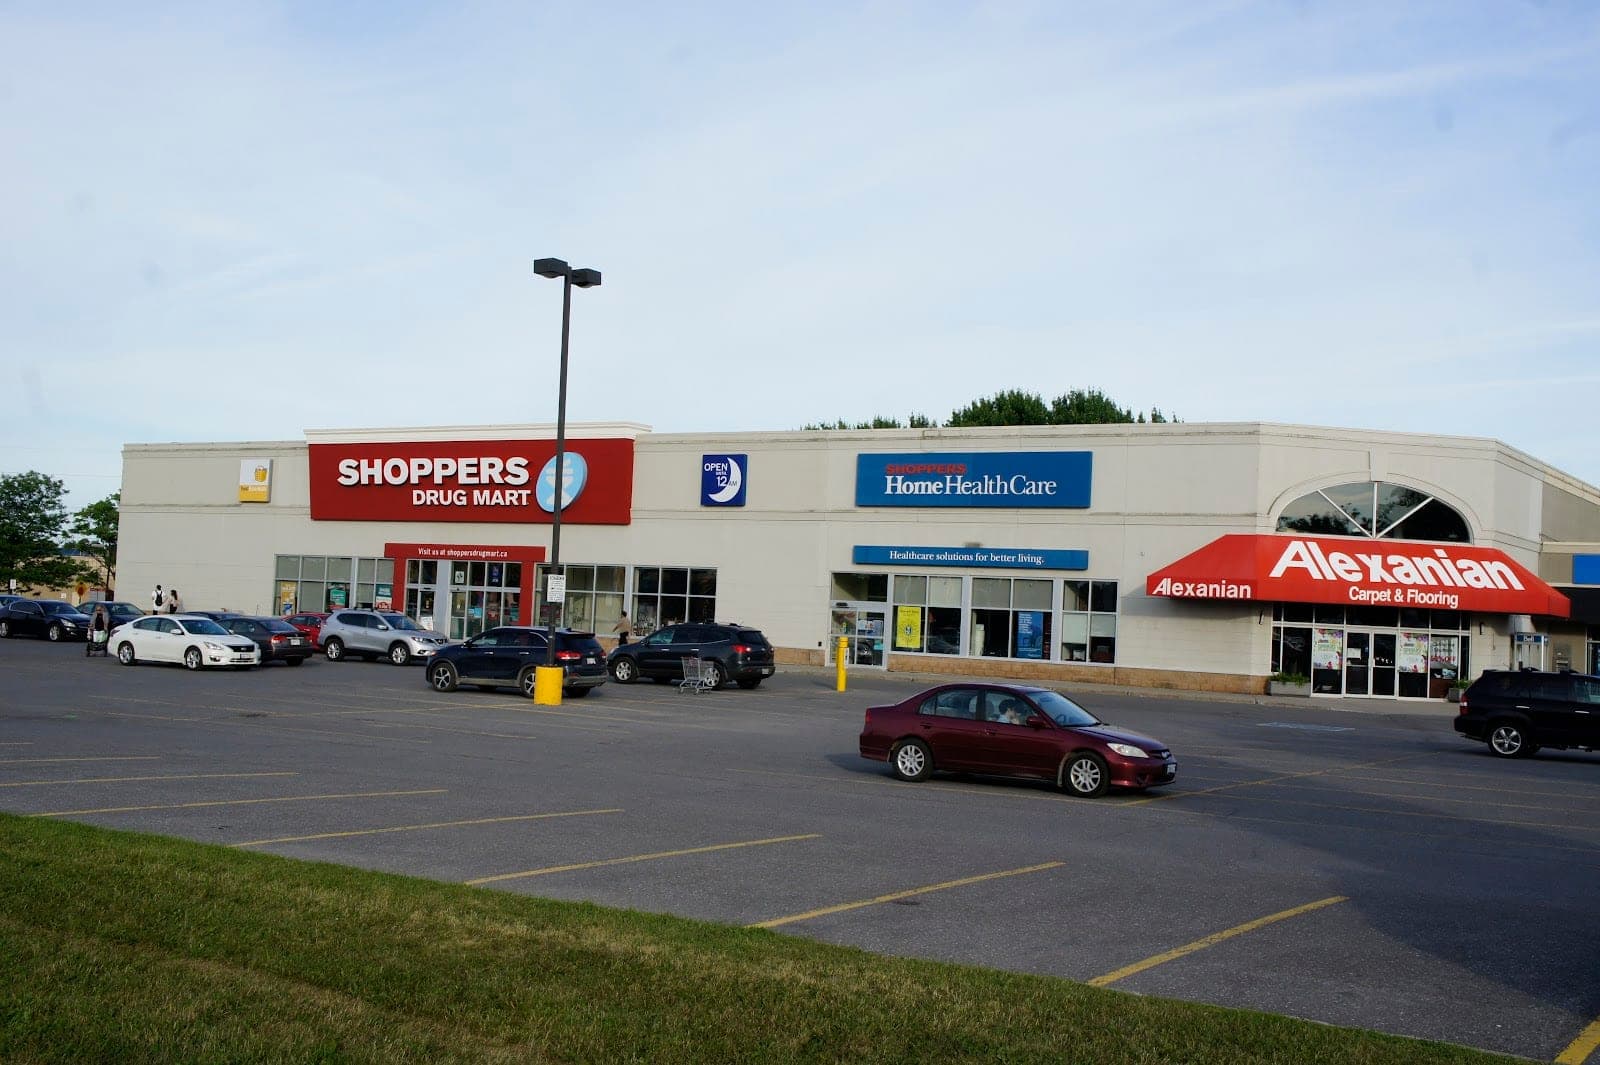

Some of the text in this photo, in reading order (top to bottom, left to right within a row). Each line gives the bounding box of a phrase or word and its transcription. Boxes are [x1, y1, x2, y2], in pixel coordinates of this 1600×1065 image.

[337, 457, 530, 486] SHOPPERS
[704, 463, 728, 471] OPEN
[886, 464, 967, 474] SHOPPERS
[716, 476, 727, 487] 12
[412, 490, 531, 506] DRUG MART
[447, 549, 508, 558] shoppersdrugmart.ca
[889, 551, 1045, 565] Healthcare solutions for better living.
[1269, 540, 1525, 591] Alexanian
[1152, 578, 1251, 599] Alexanian
[1349, 586, 1459, 609] Carpet & Flooring
